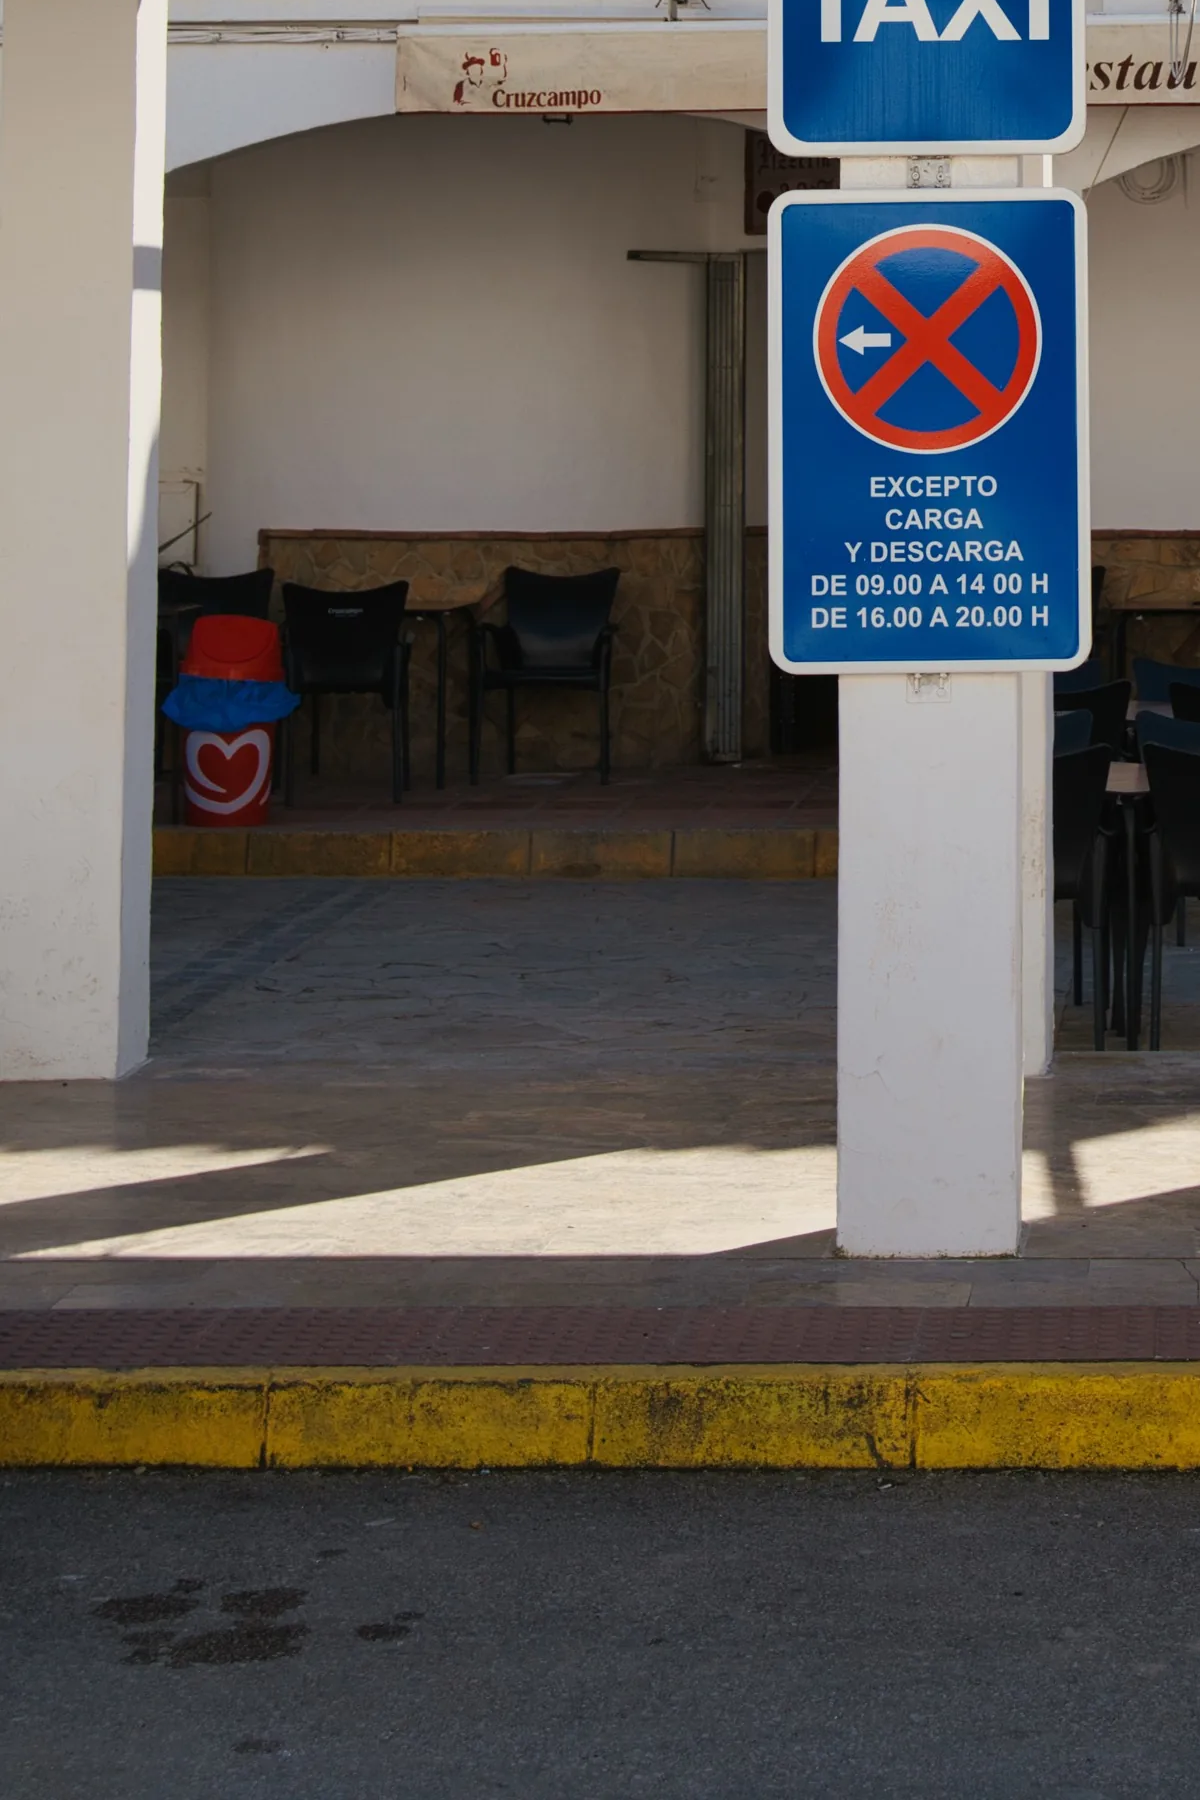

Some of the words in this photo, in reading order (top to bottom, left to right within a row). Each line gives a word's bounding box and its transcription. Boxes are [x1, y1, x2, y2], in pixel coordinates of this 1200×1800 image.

[492, 89, 602, 108] Cruzcampo
[870, 476, 997, 498] EXCEPTO
[885, 508, 983, 530] CARGA
[844, 542, 862, 562] Y
[871, 541, 1024, 563] DESCARGA
[811, 575, 847, 596] DE
[856, 574, 922, 596] 09.00
[929, 574, 949, 595] A
[1031, 573, 1049, 594] H
[811, 608, 847, 629] DE
[857, 607, 922, 628] 16.00
[930, 607, 949, 628] A
[956, 606, 1022, 627] 20.00
[1031, 606, 1049, 627] H
